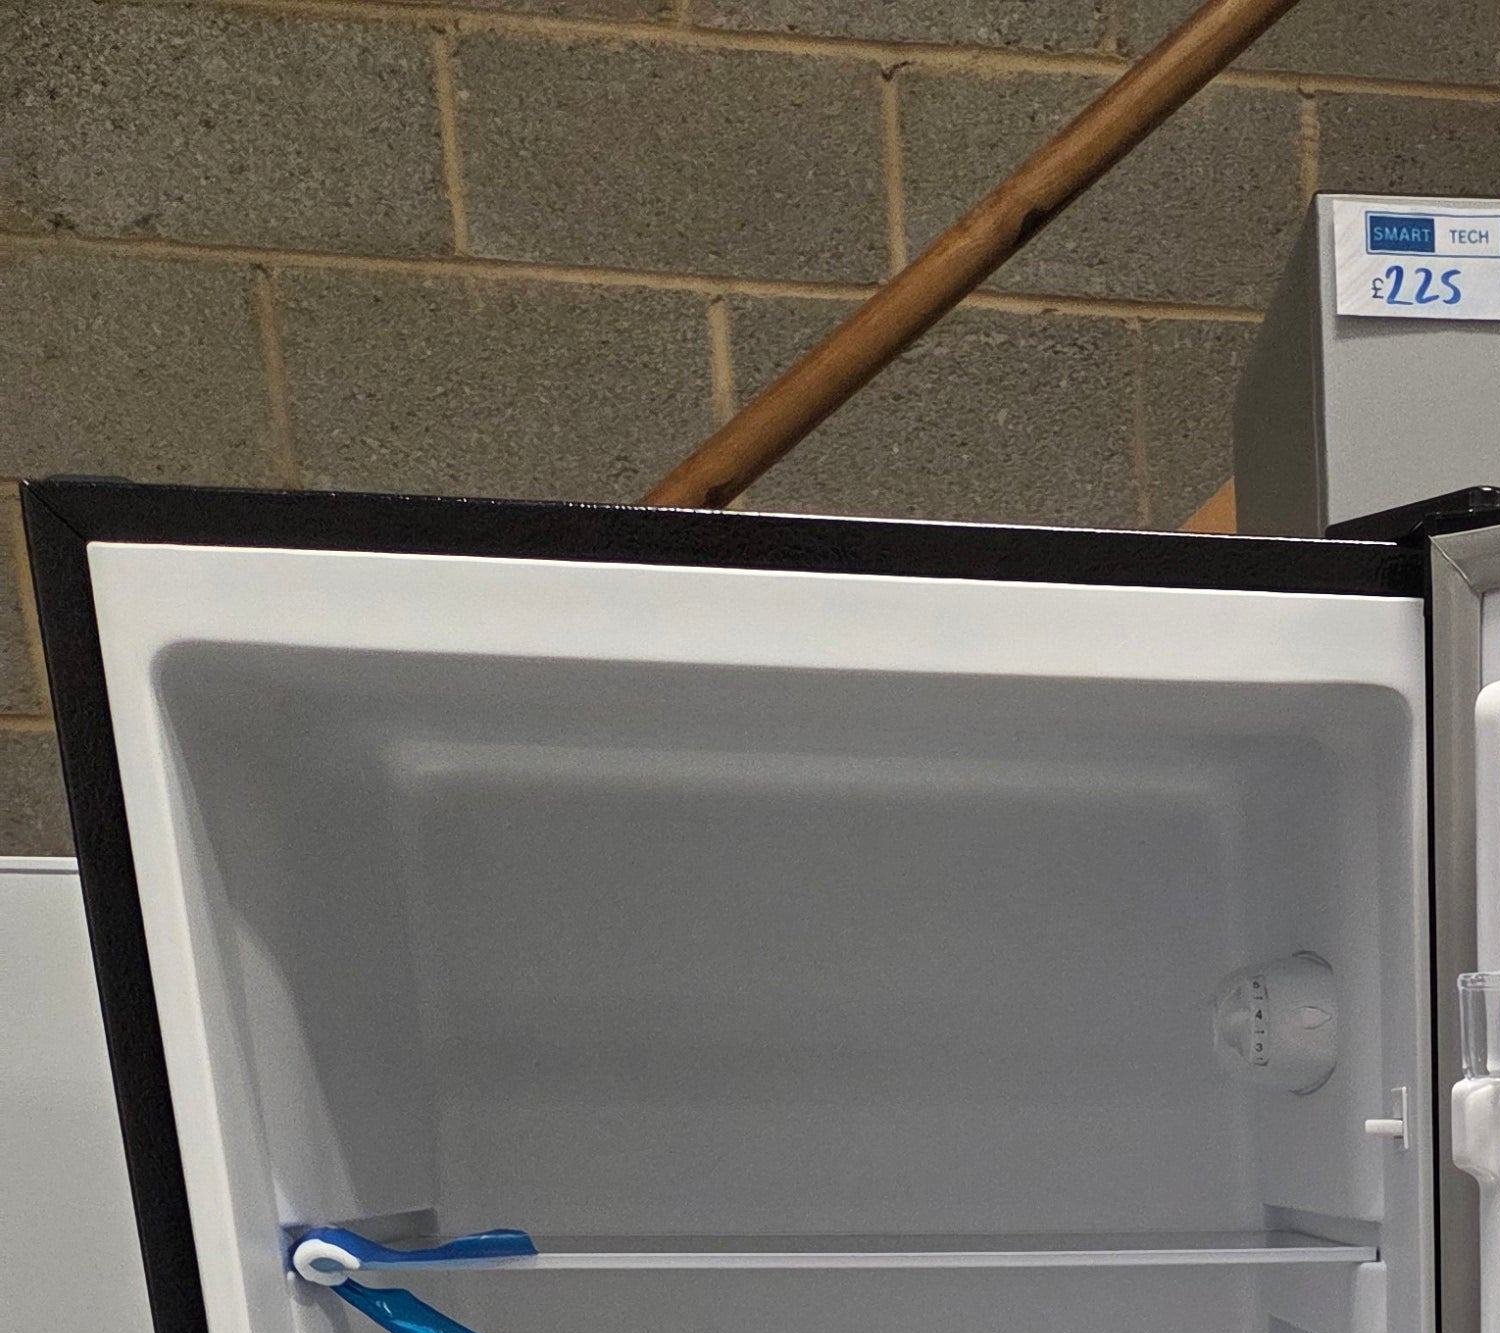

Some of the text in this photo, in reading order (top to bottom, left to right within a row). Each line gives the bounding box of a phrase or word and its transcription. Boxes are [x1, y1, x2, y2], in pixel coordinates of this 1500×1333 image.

[1373, 226, 1489, 244] SMART TECH
[1371, 265, 1462, 305] £225
